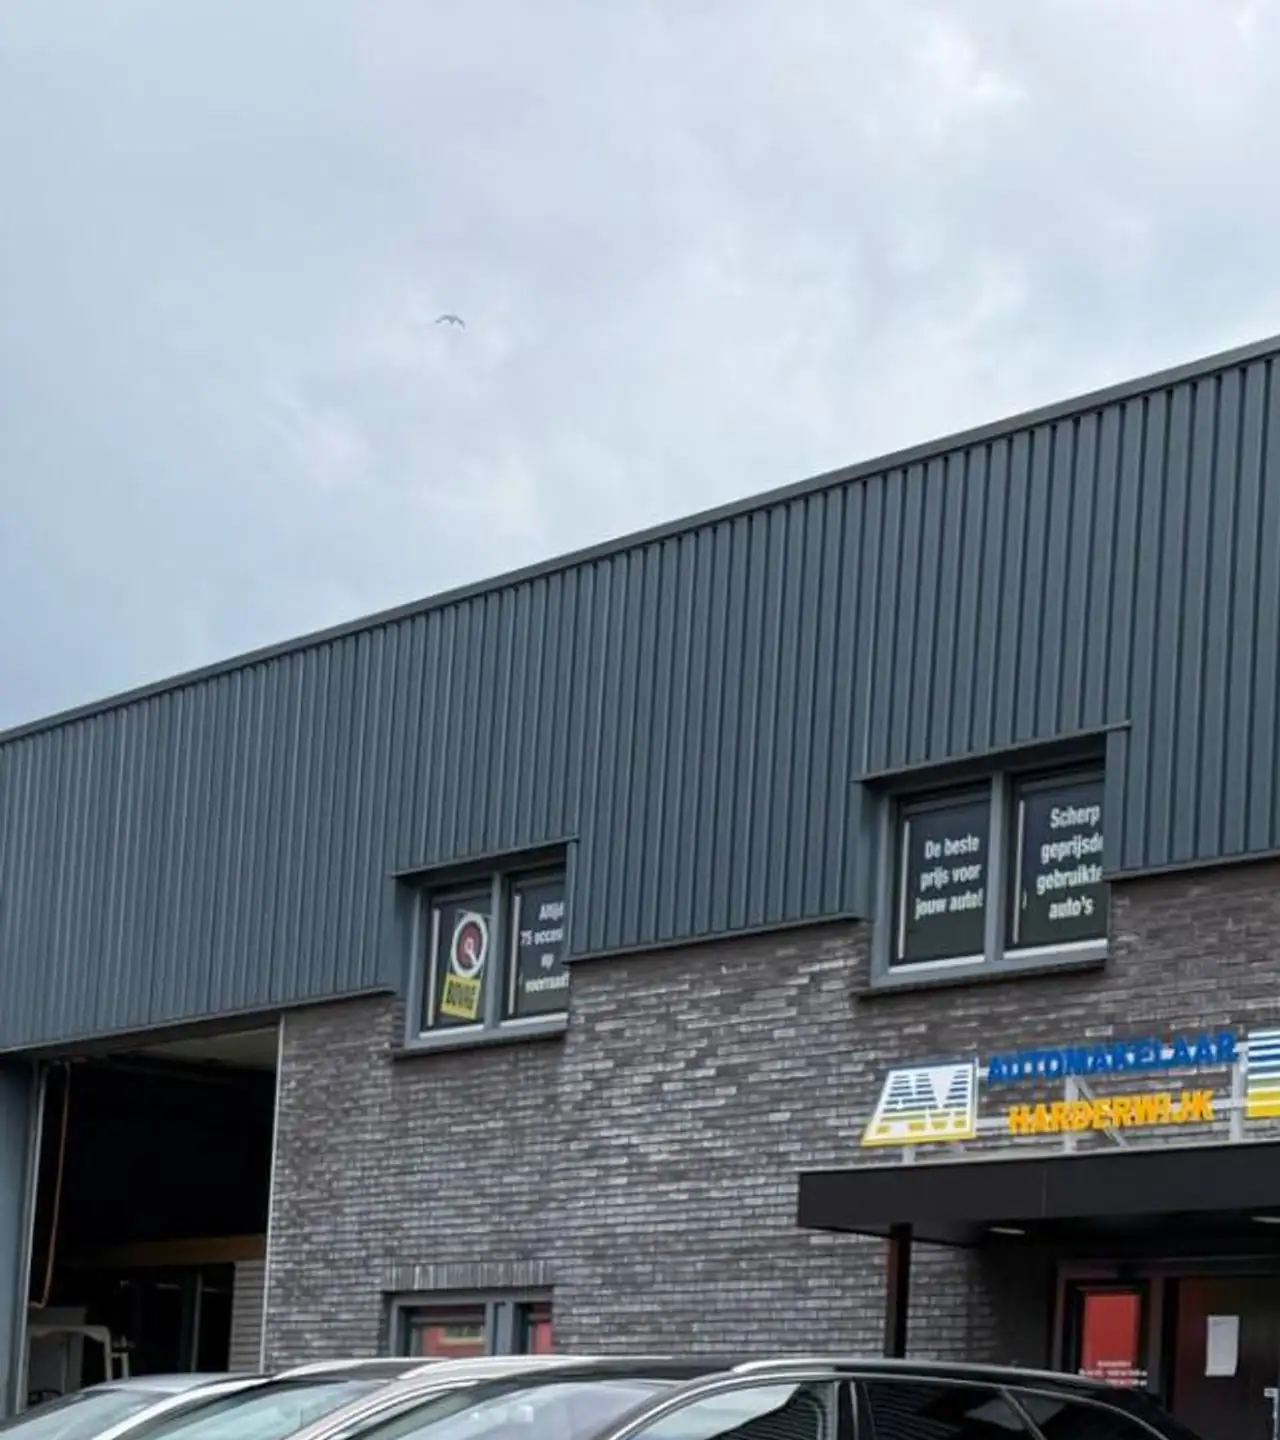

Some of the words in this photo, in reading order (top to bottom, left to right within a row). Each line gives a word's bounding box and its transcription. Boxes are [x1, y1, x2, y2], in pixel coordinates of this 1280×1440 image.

[1050, 806, 1100, 828] Scherp
[1049, 895, 1093, 920] auto's
[988, 1033, 1237, 1085] AUTOMAKELAAR
[1007, 1090, 1215, 1135] HARDERWIJK
